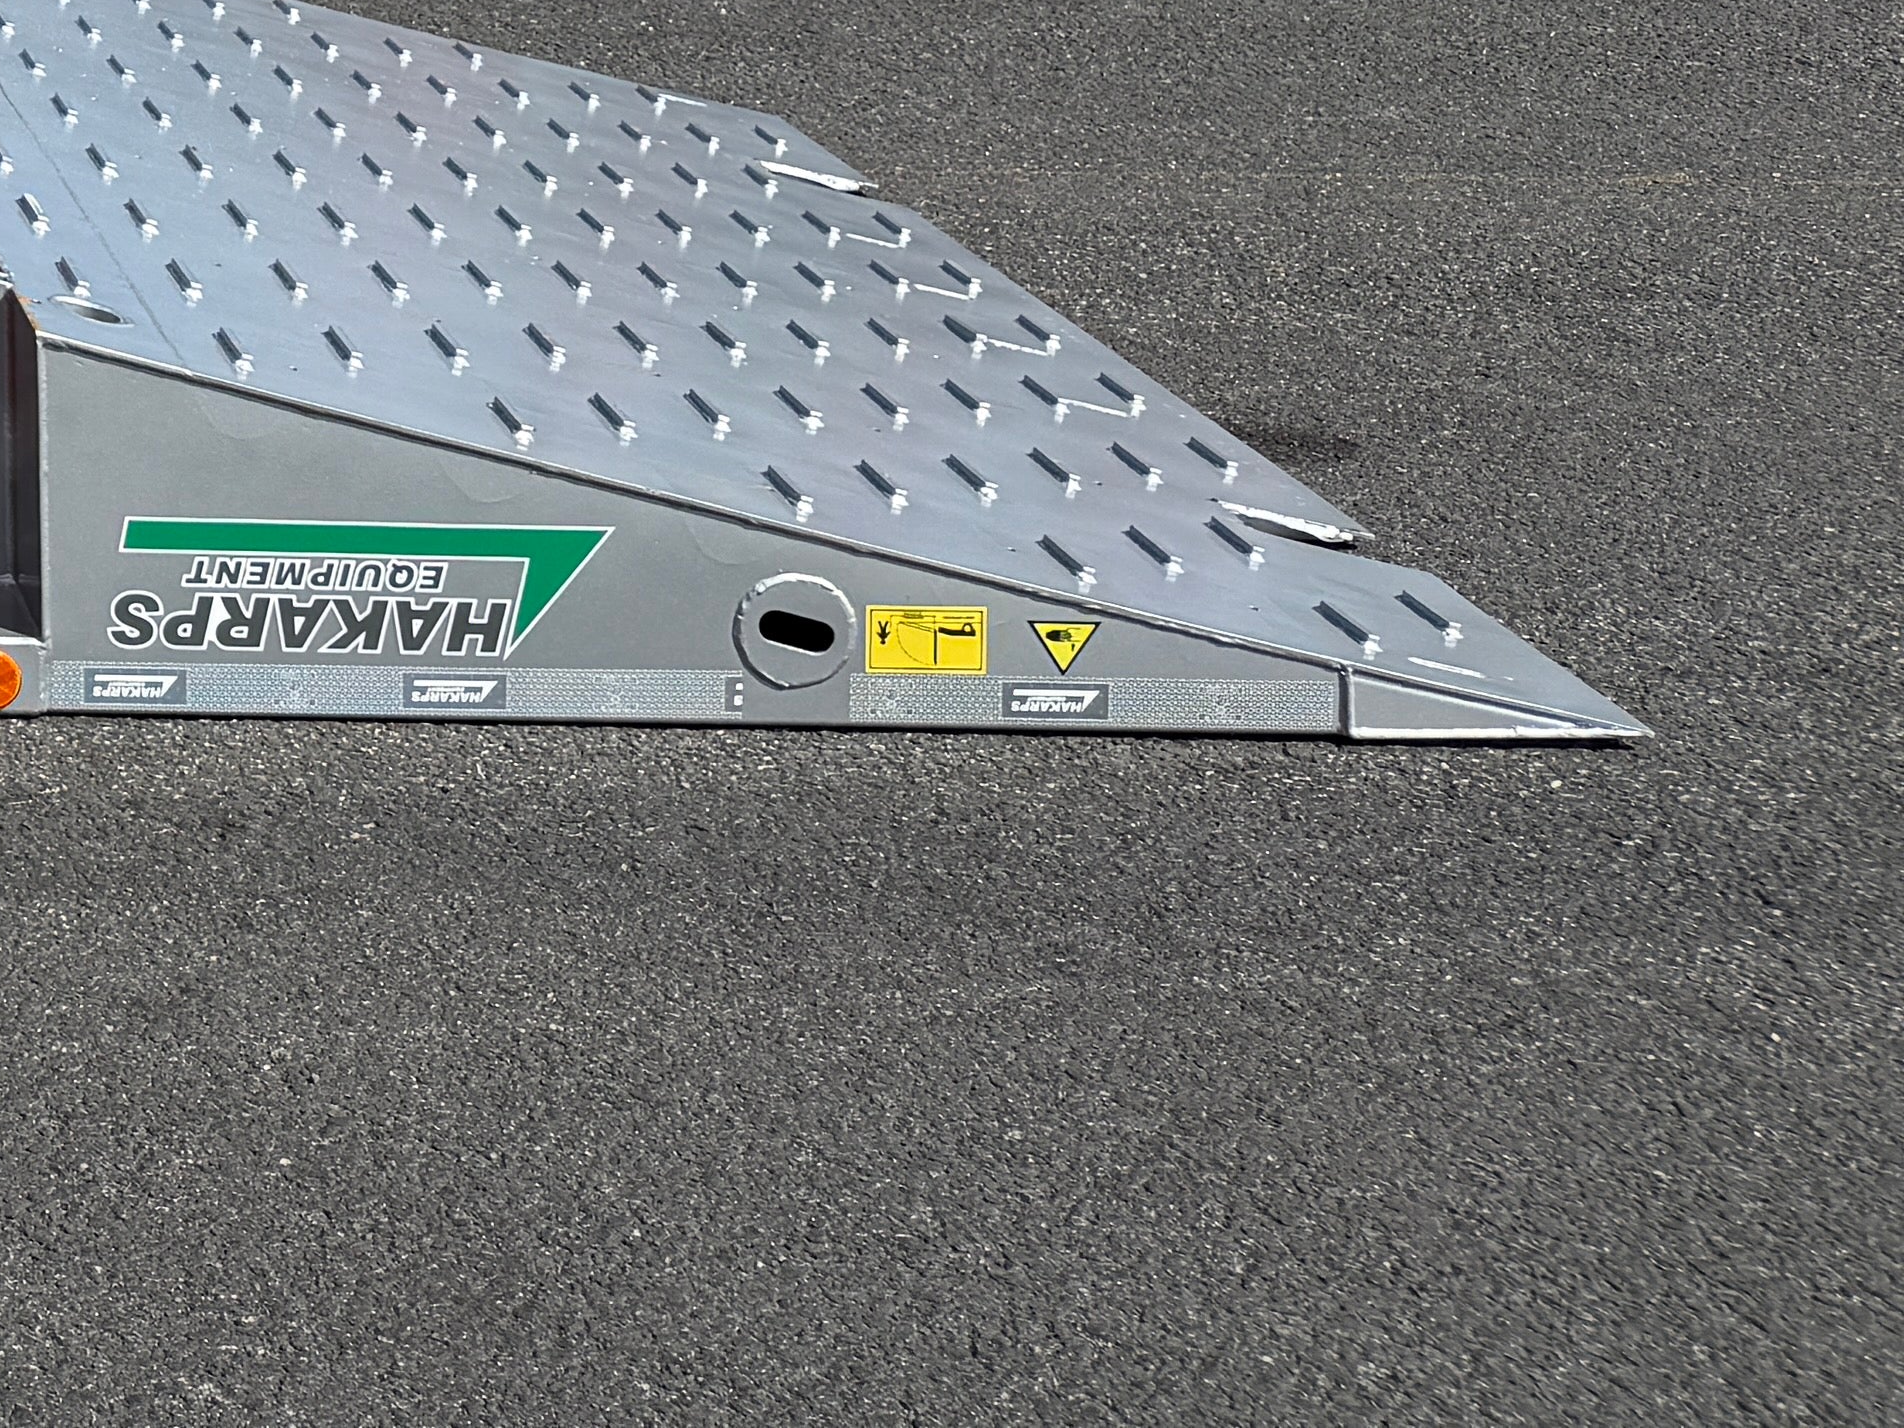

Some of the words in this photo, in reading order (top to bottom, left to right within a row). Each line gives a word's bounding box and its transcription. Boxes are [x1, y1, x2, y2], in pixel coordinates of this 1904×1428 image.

[182, 555, 449, 594] EQUIPMENT
[108, 590, 513, 657] HAKARPS
[93, 685, 162, 698] HAKARPS
[411, 690, 482, 703] HAKARPS
[1011, 700, 1083, 713] HAKARPS
